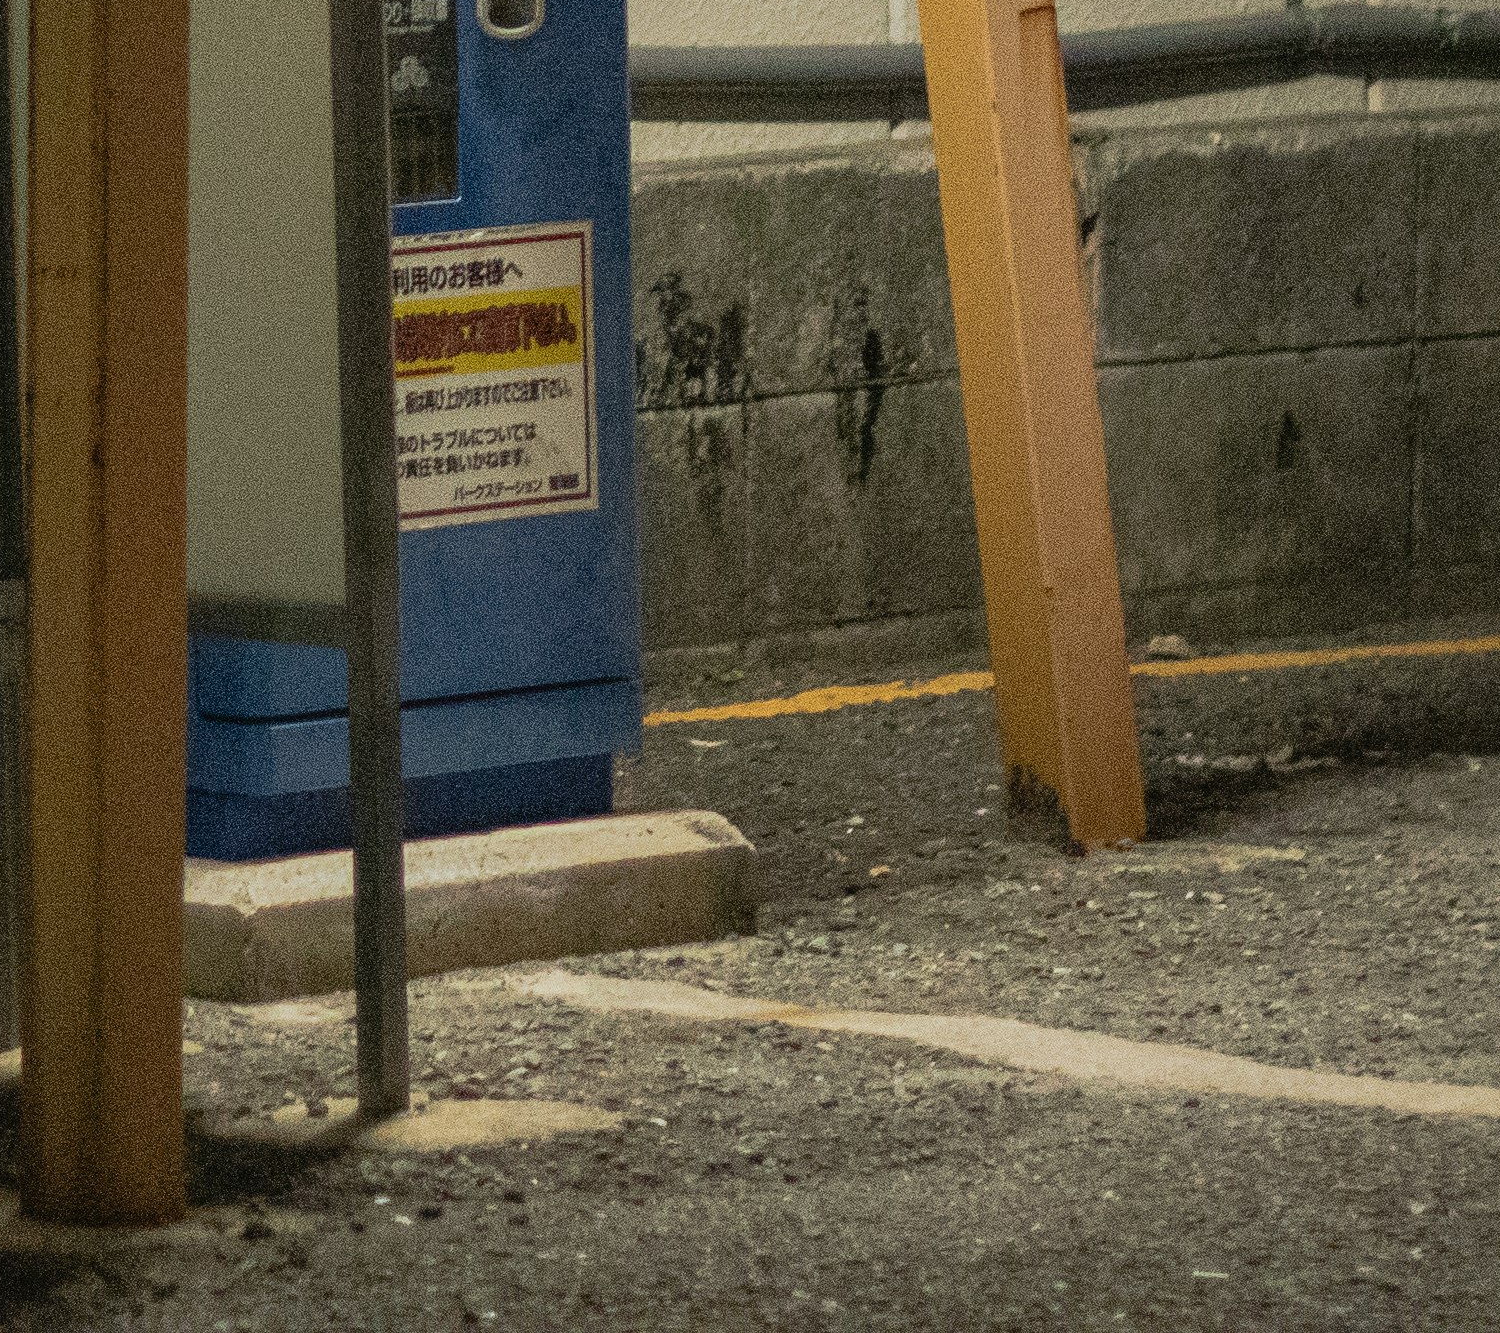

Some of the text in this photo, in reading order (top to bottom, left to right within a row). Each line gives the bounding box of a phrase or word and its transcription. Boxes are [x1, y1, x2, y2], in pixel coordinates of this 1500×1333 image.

[393, 258, 523, 295] 利用のお客様へ
[453, 479, 543, 501] パークステーション
